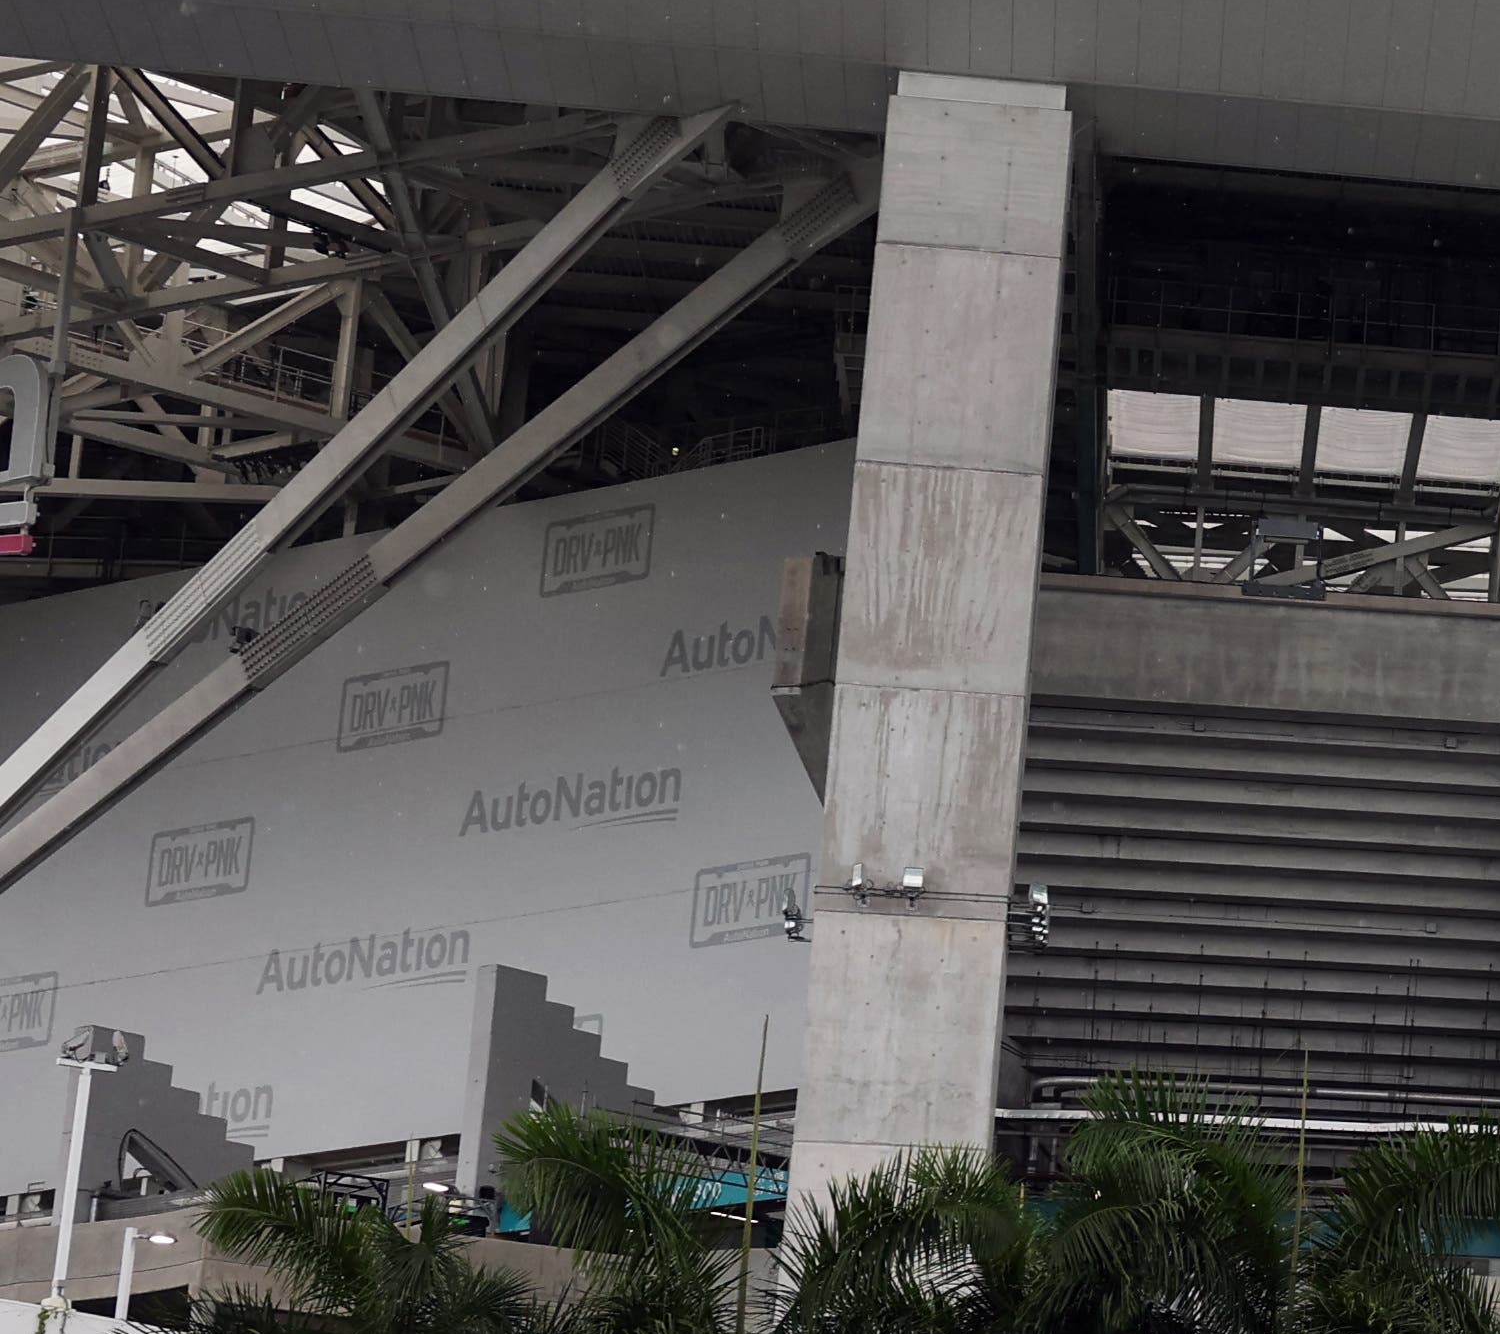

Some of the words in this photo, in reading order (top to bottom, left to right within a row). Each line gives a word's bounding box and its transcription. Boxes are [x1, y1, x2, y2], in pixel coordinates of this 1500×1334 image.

[553, 533, 595, 577] DRV
[601, 523, 642, 566] PNK
[350, 688, 390, 733] DRV
[398, 680, 436, 723] PNK
[458, 766, 682, 837] AutoNation
[158, 844, 198, 887] DRV
[204, 835, 243, 878] PNK
[703, 880, 747, 927] DRV
[255, 927, 471, 995] AutoNation
[7, 992, 46, 1032] PNK
